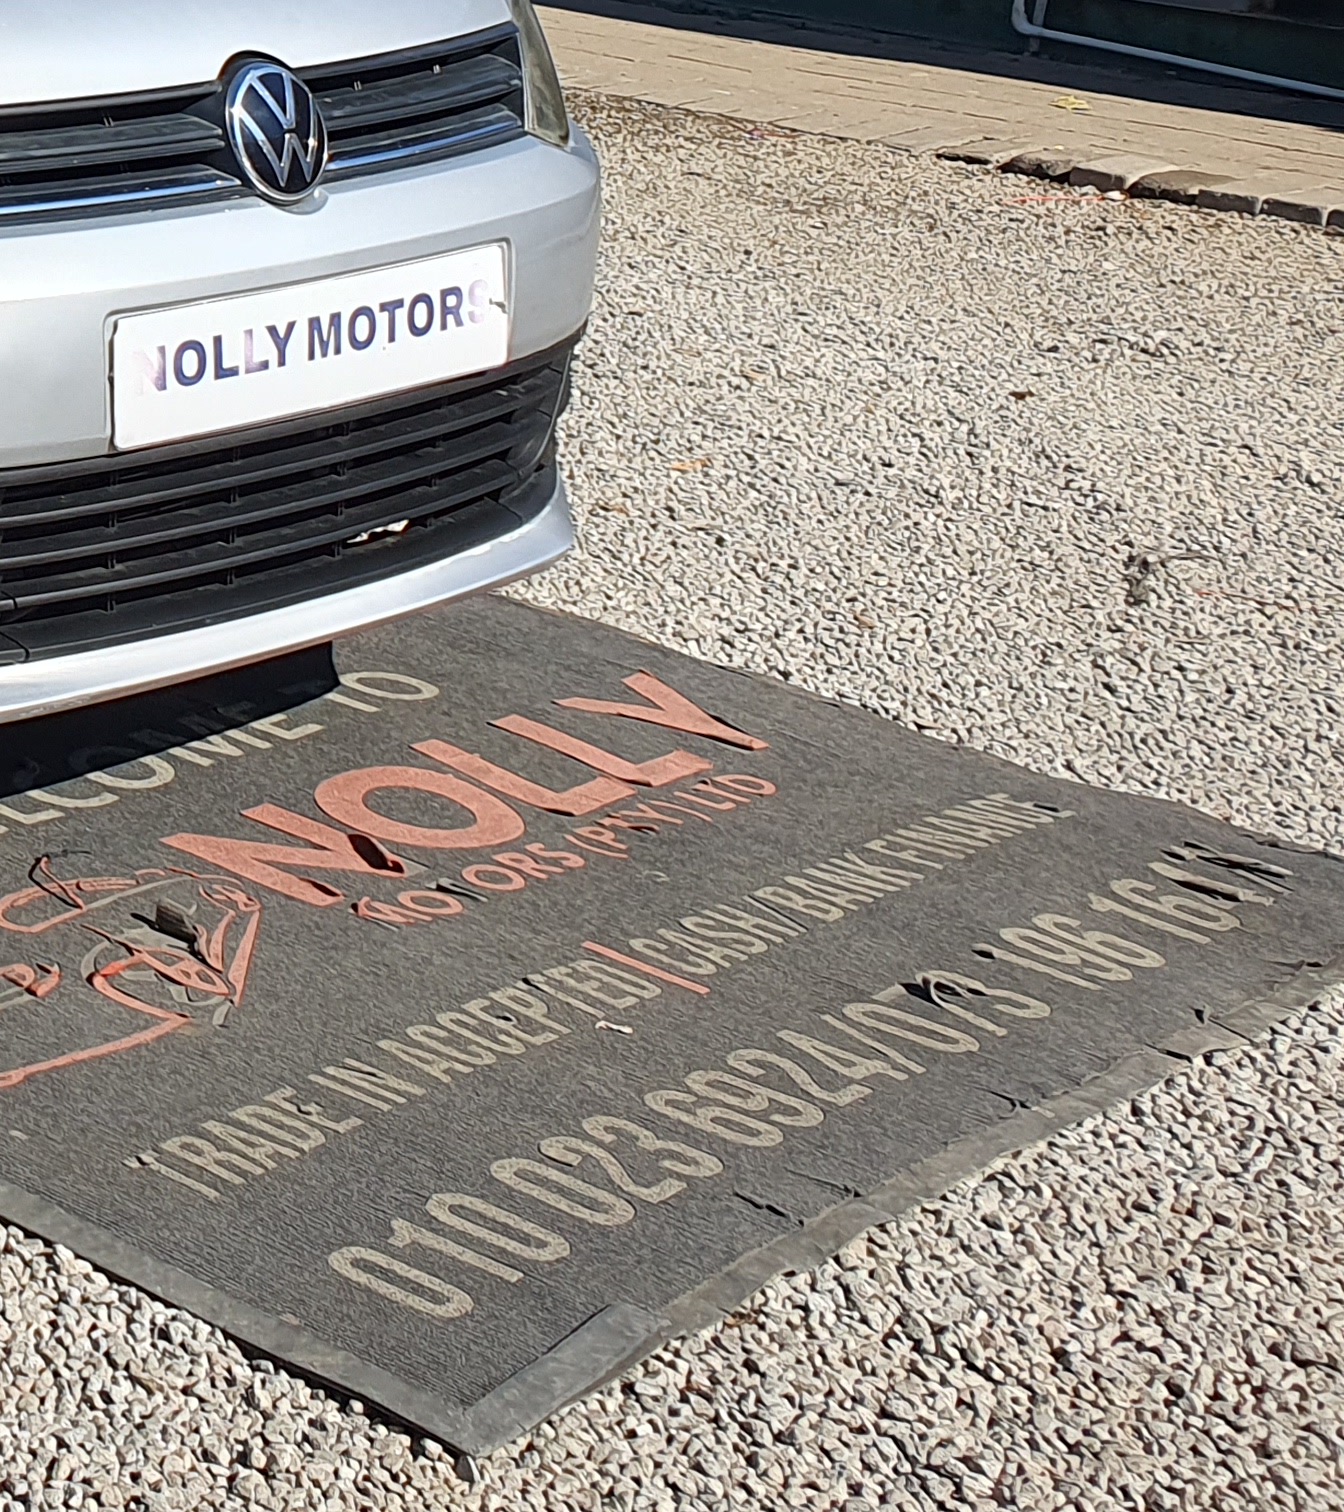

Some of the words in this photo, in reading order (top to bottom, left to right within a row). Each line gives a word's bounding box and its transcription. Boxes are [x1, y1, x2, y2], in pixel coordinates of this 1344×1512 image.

[132, 320, 297, 396] NOLLY
[307, 279, 491, 362] MOTORS
[158, 668, 771, 908] NOLLY
[287, 670, 440, 713] TO
[122, 1086, 365, 1200] TRADE
[308, 1057, 427, 1112] IN
[376, 957, 662, 1082] ACCEPTED
[628, 848, 925, 976] CASH/BANK
[863, 792, 1077, 870] FINANCE
[327, 1190, 572, 1320] 010
[490, 1114, 725, 1228] 023
[971, 913, 1167, 991] 196
